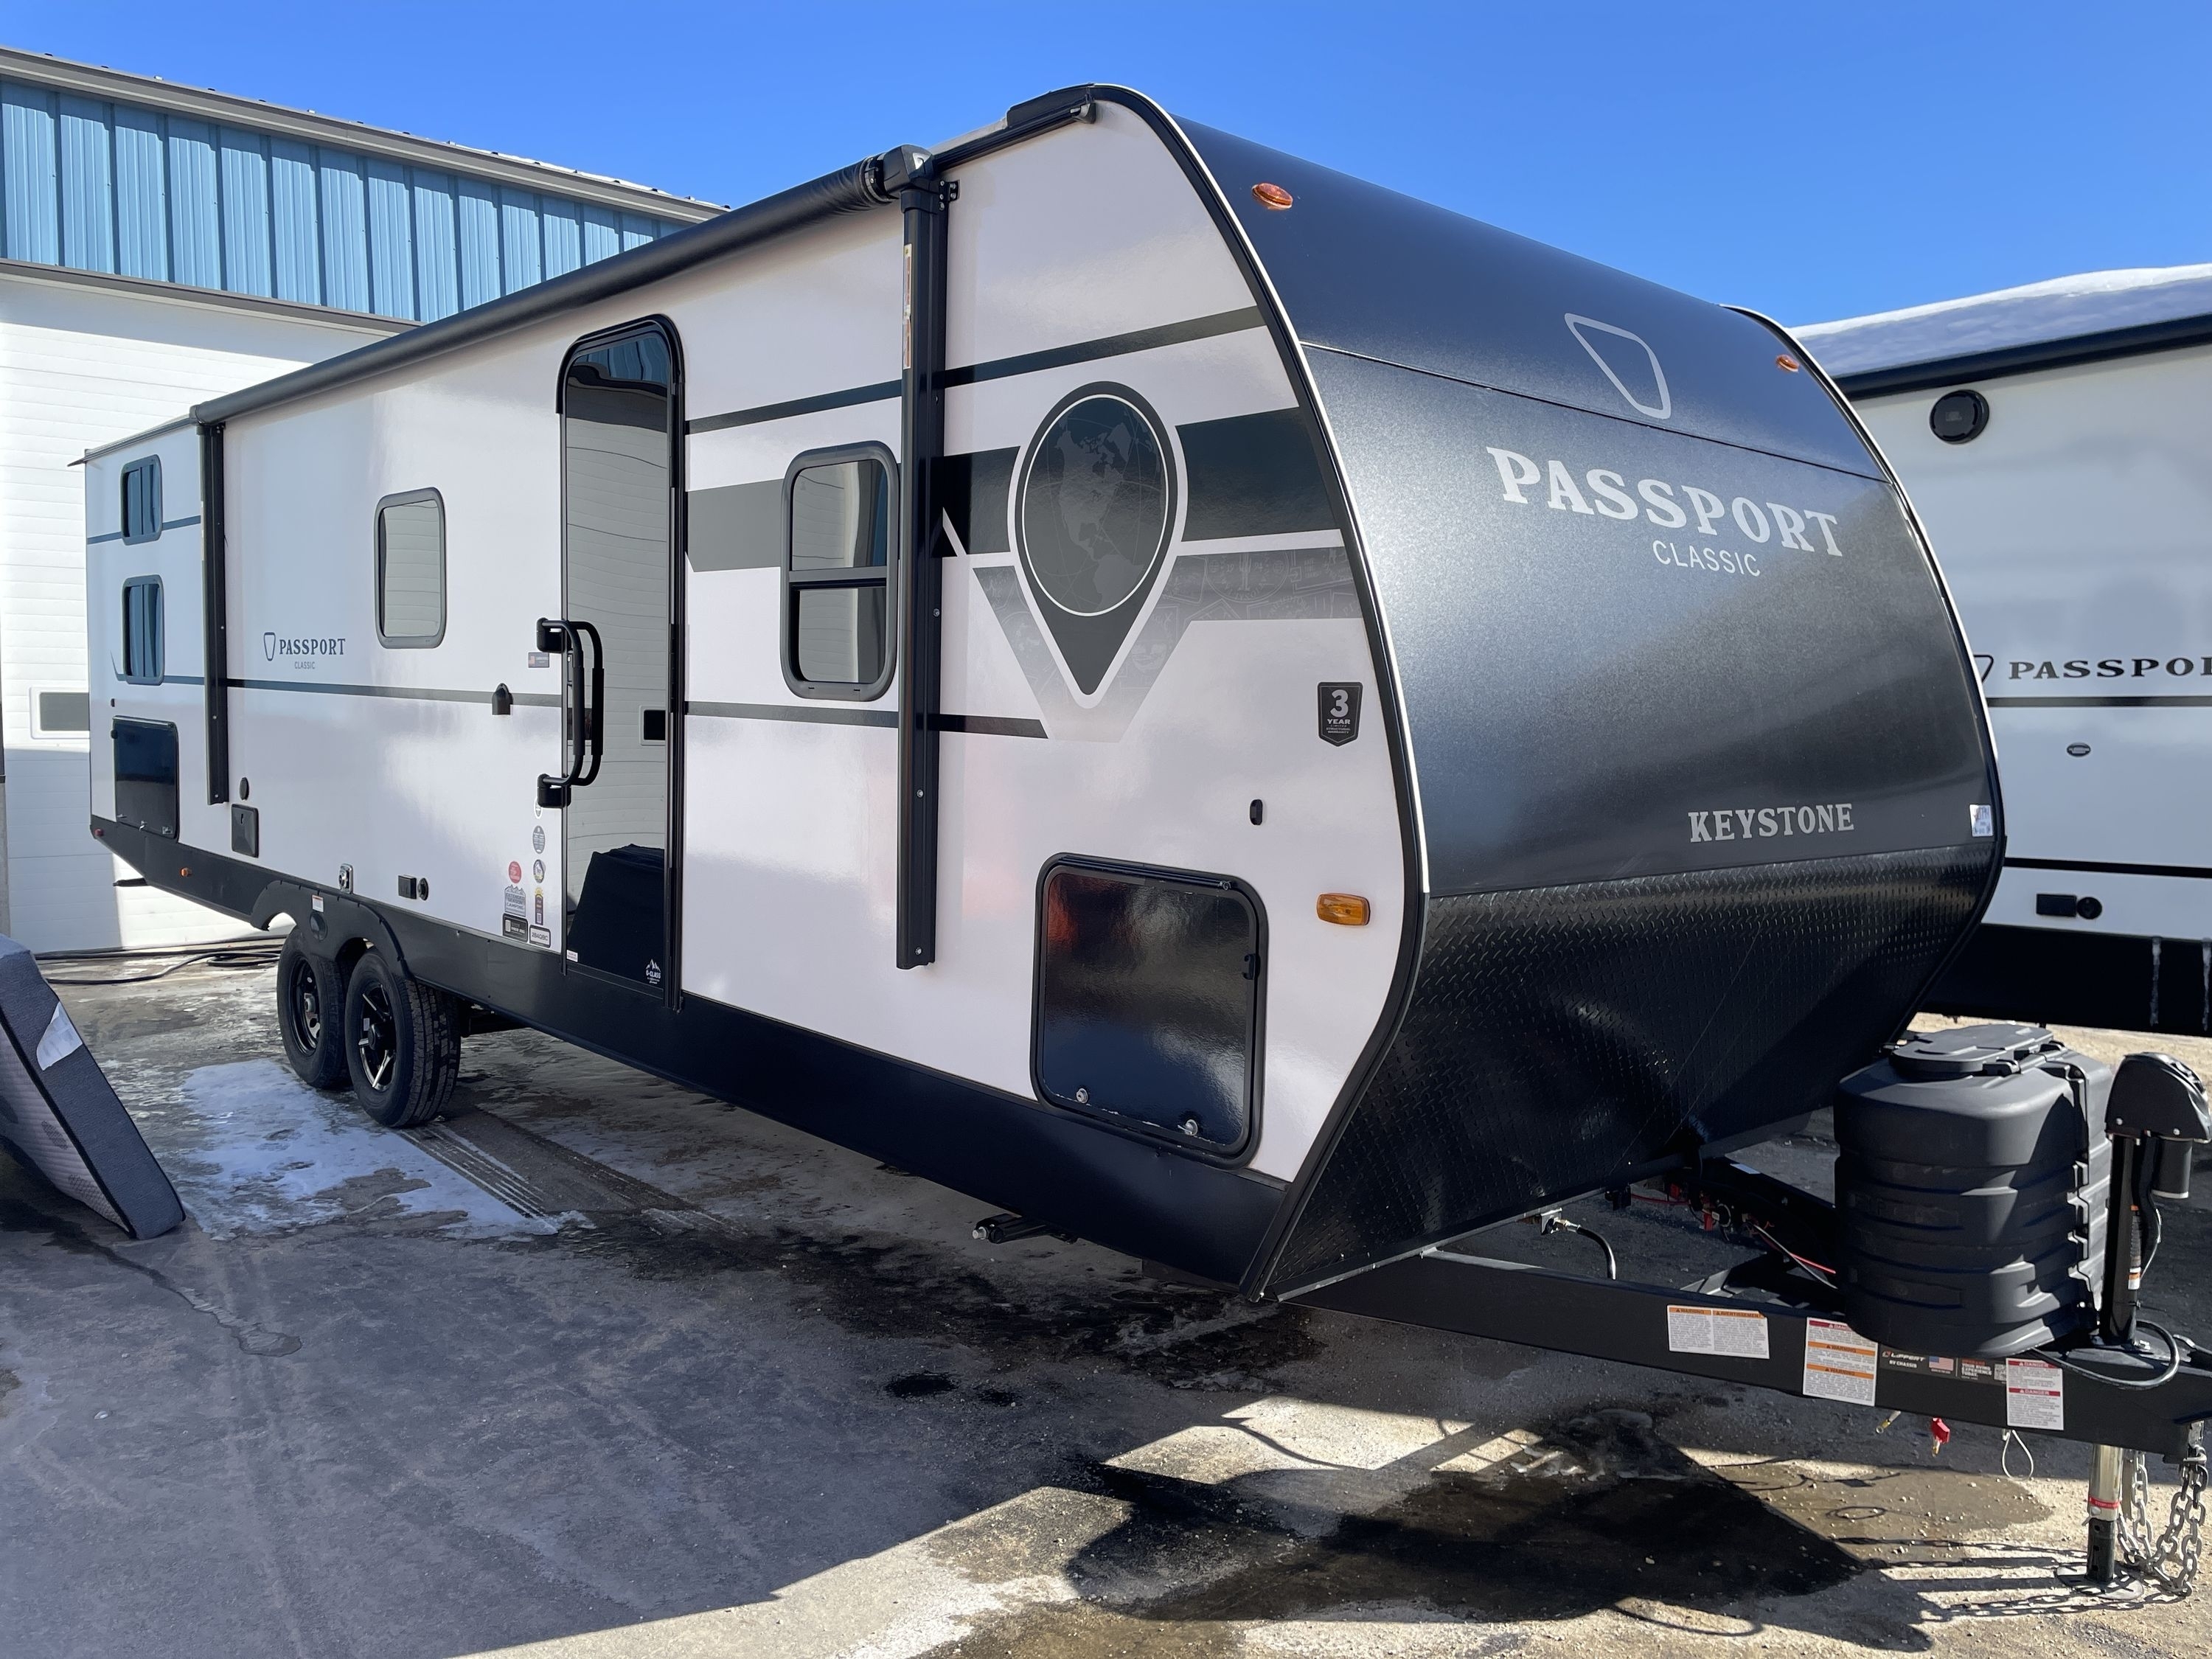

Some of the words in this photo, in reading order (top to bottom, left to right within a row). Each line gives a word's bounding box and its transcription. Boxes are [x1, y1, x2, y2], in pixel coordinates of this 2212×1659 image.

[1486, 446, 1843, 557] PASSPORT
[1652, 540, 1761, 577] CLASSIC
[279, 638, 346, 655] PASSPORT
[294, 661, 316, 669] CLASSIC
[1329, 689, 1349, 718] 3
[1688, 803, 1855, 844] KEYSTONE
[1831, 1345, 1857, 1354] WARNING
[1829, 1368, 1856, 1377] WARNING
[1896, 1360, 1917, 1369] CHASSIS
